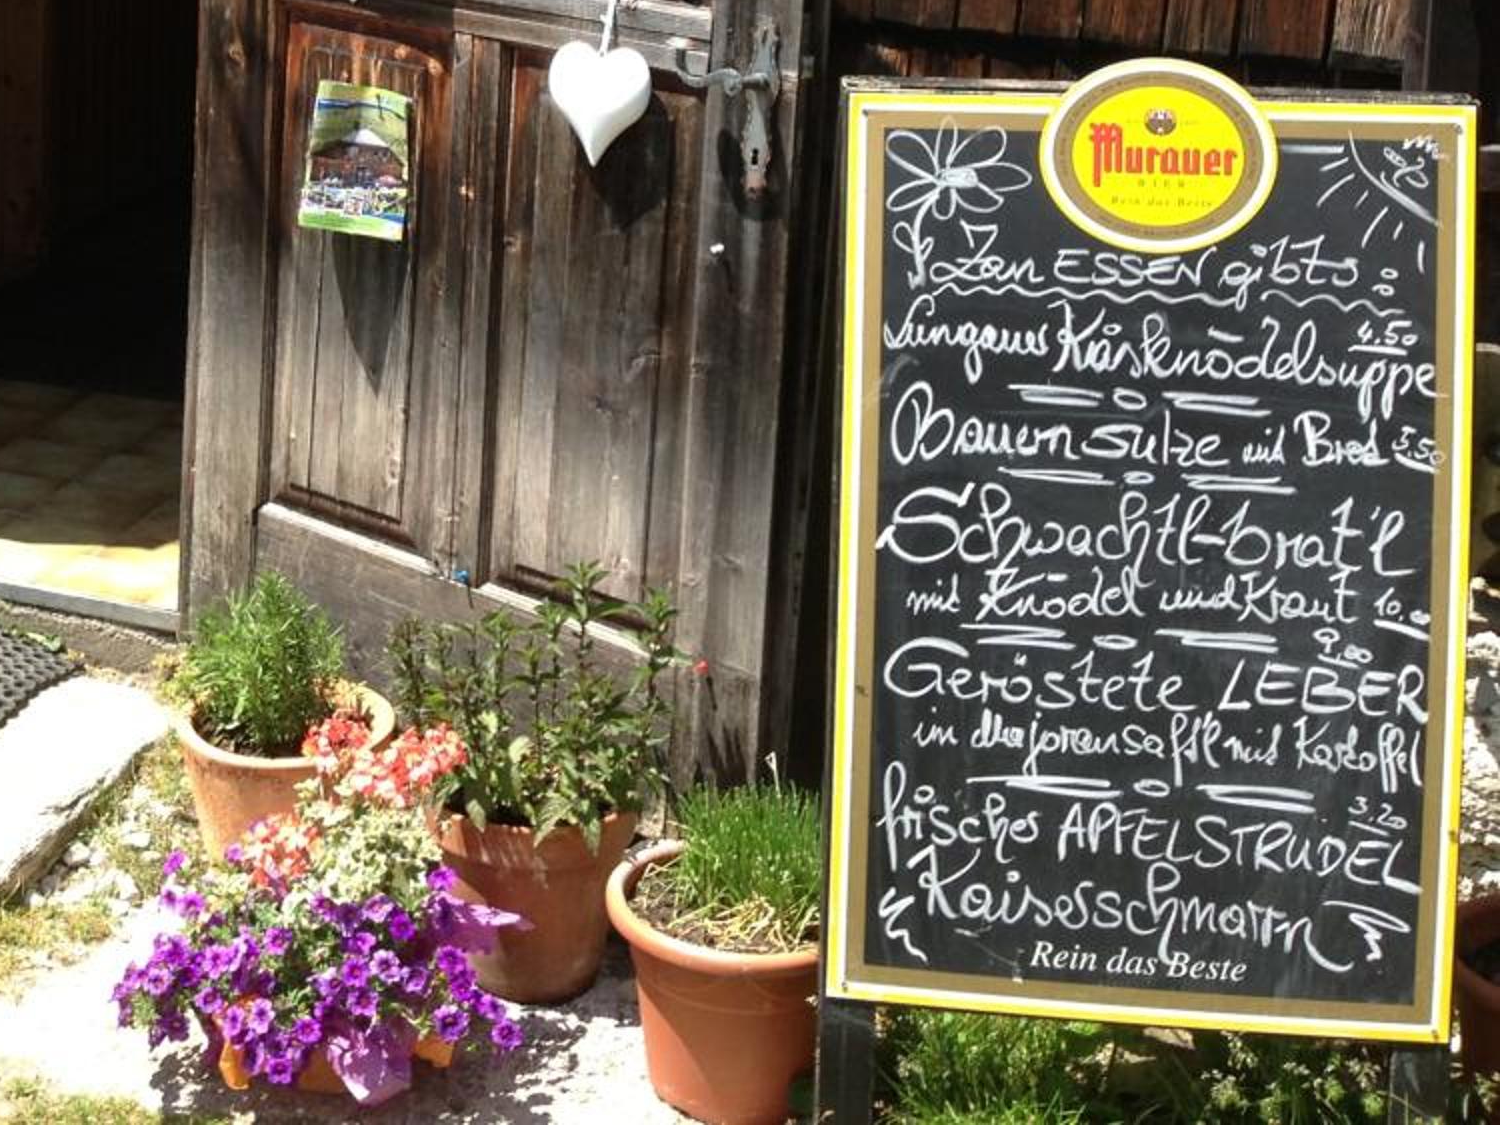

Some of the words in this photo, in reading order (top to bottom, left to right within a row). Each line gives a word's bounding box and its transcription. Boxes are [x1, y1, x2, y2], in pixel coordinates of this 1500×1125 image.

[1089, 122, 1238, 187] Murauer
[1053, 248, 1216, 287] ESSEN
[884, 636, 1198, 712] Geröstete
[1216, 658, 1430, 723] LEBER
[1056, 801, 1424, 894] APFELSTRUDEL
[1030, 938, 1101, 972] Rein
[1106, 946, 1158, 976] das
[1166, 955, 1248, 983] Beste
